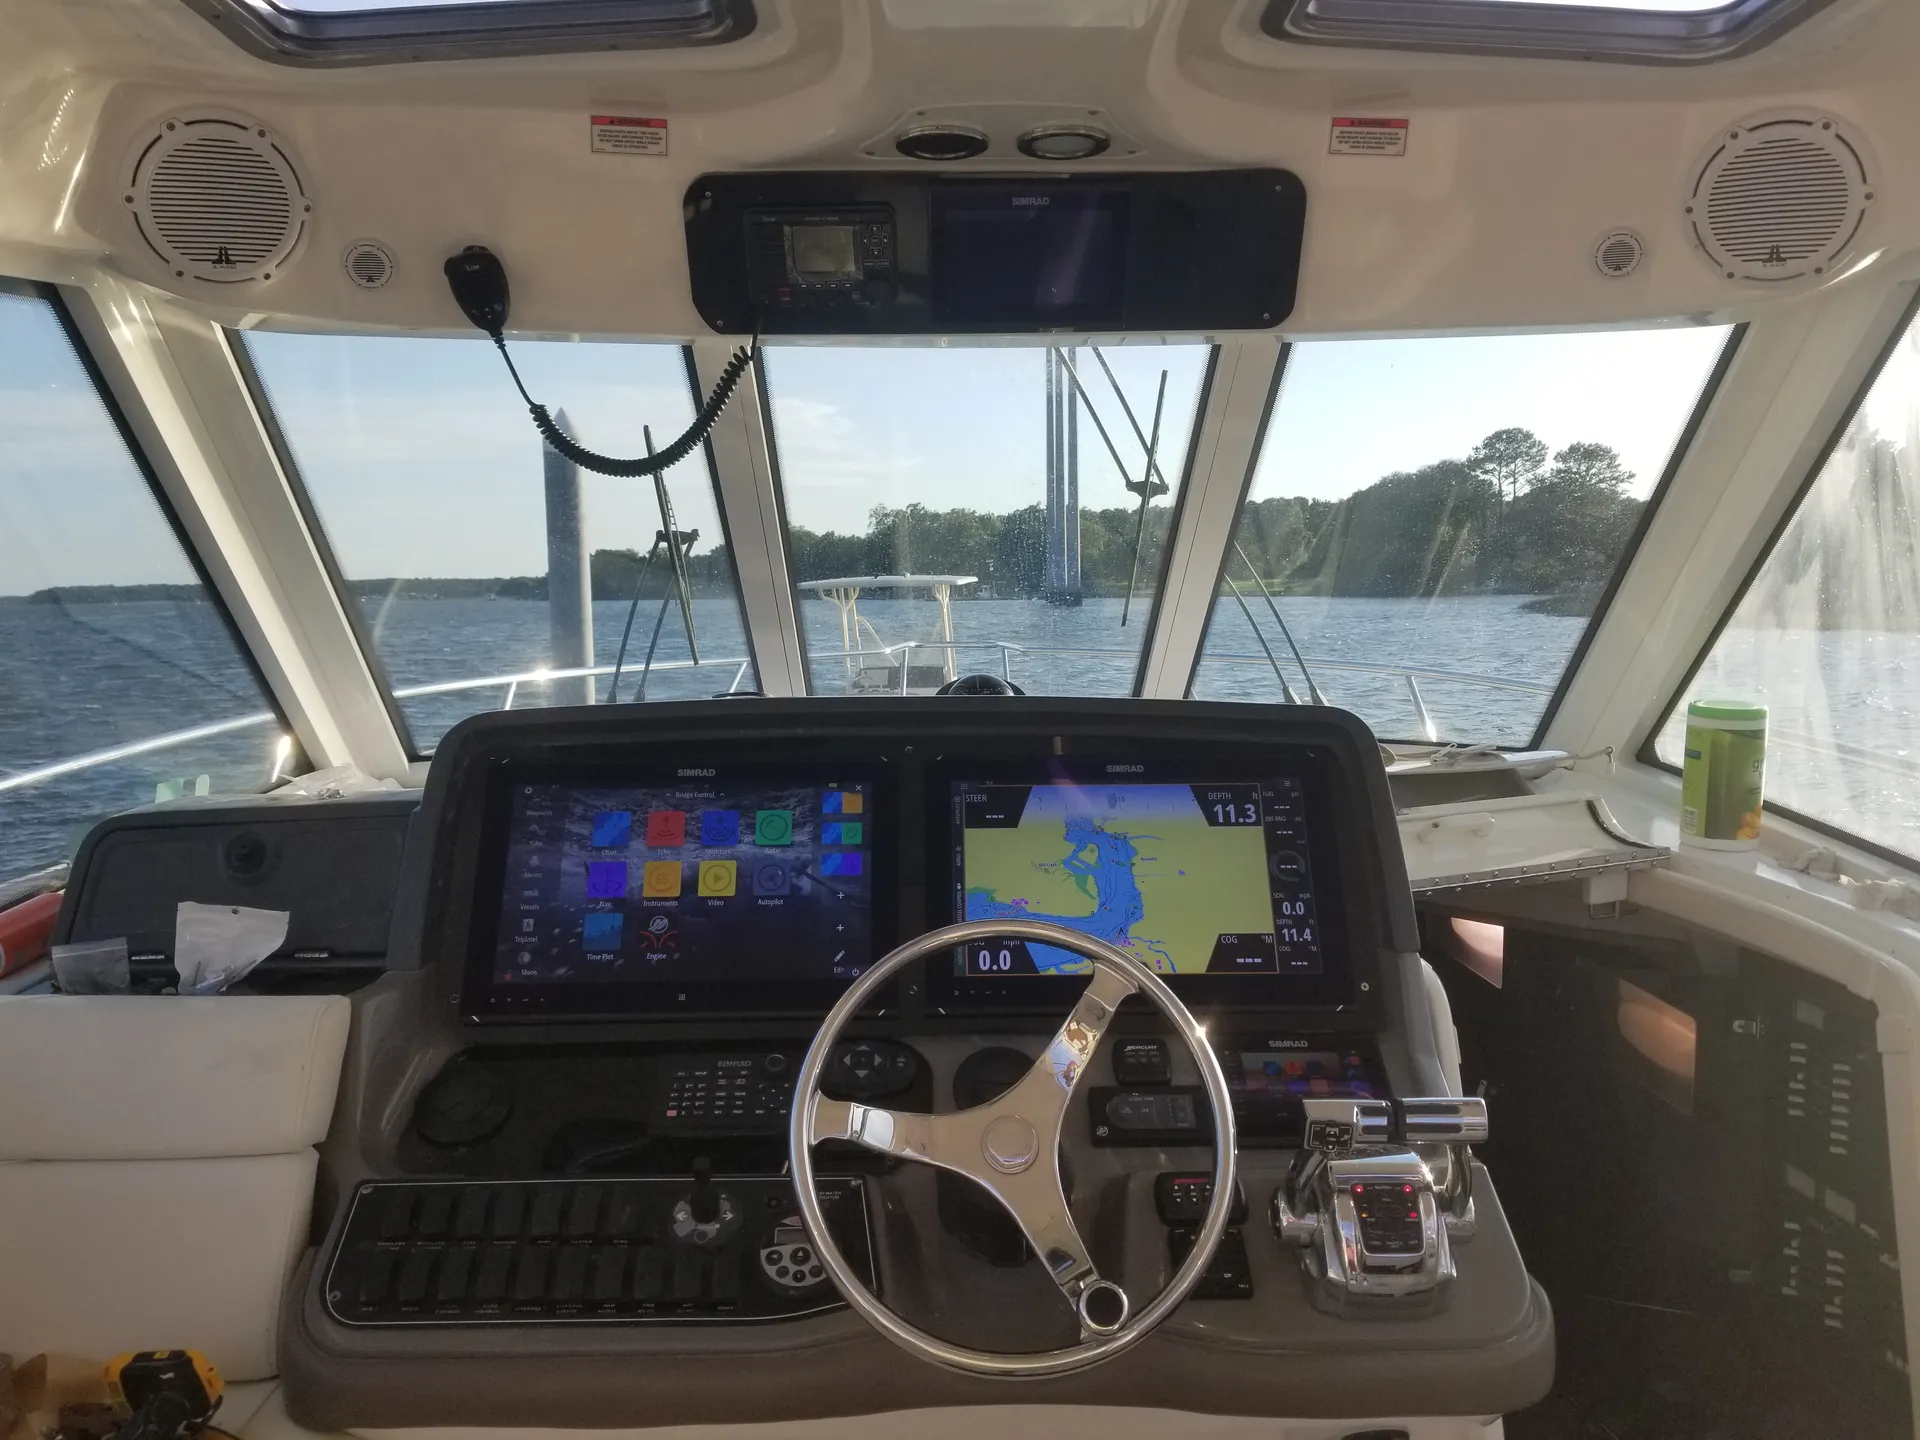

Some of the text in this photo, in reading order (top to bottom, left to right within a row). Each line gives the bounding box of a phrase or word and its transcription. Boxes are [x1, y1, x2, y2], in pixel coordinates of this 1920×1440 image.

[1011, 196, 1050, 206] SIMRAD
[676, 768, 716, 777] SIMRAD
[1106, 765, 1144, 773] SIMRAD
[675, 791, 716, 799] Bridge Control
[965, 794, 987, 802] STEER
[1208, 792, 1232, 800] DEPTH
[1252, 792, 1259, 800] ft
[1213, 803, 1257, 823] 11.3
[1299, 893, 1311, 901] mph
[520, 903, 540, 911] Vessels
[643, 900, 679, 908] Instruments
[707, 899, 724, 907] Video
[757, 899, 784, 907] Autopilot
[1282, 901, 1305, 916] 0.0
[1281, 928, 1313, 942] 11.4
[1220, 935, 1238, 944] COG
[587, 953, 614, 961] Time Plot
[646, 953, 667, 962] Engine
[978, 949, 1012, 971] 0.0
[1268, 1040, 1309, 1049] SIMRAD
[717, 1060, 752, 1068] SIMRAD
